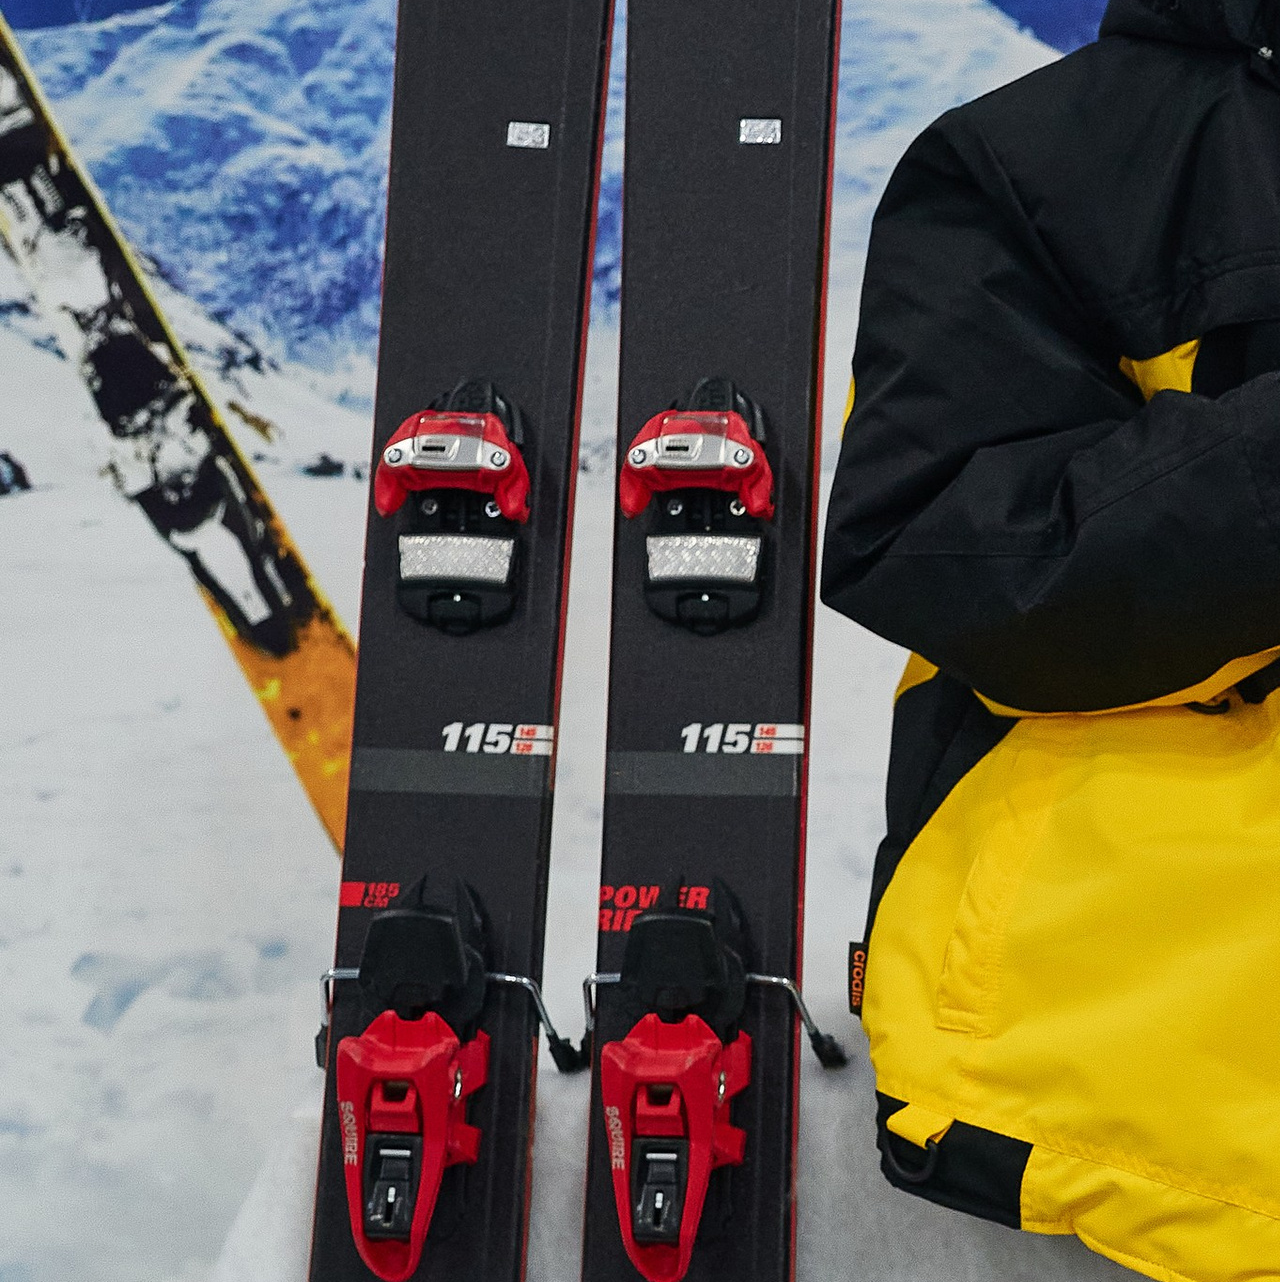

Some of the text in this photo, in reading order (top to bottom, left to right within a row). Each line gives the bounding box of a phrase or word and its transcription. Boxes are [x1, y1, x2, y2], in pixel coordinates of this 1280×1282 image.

[442, 721, 514, 754] 115
[681, 722, 751, 754] 115
[340, 1100, 358, 1167] SQUIRE
[605, 1105, 626, 1171] SQUIRE
